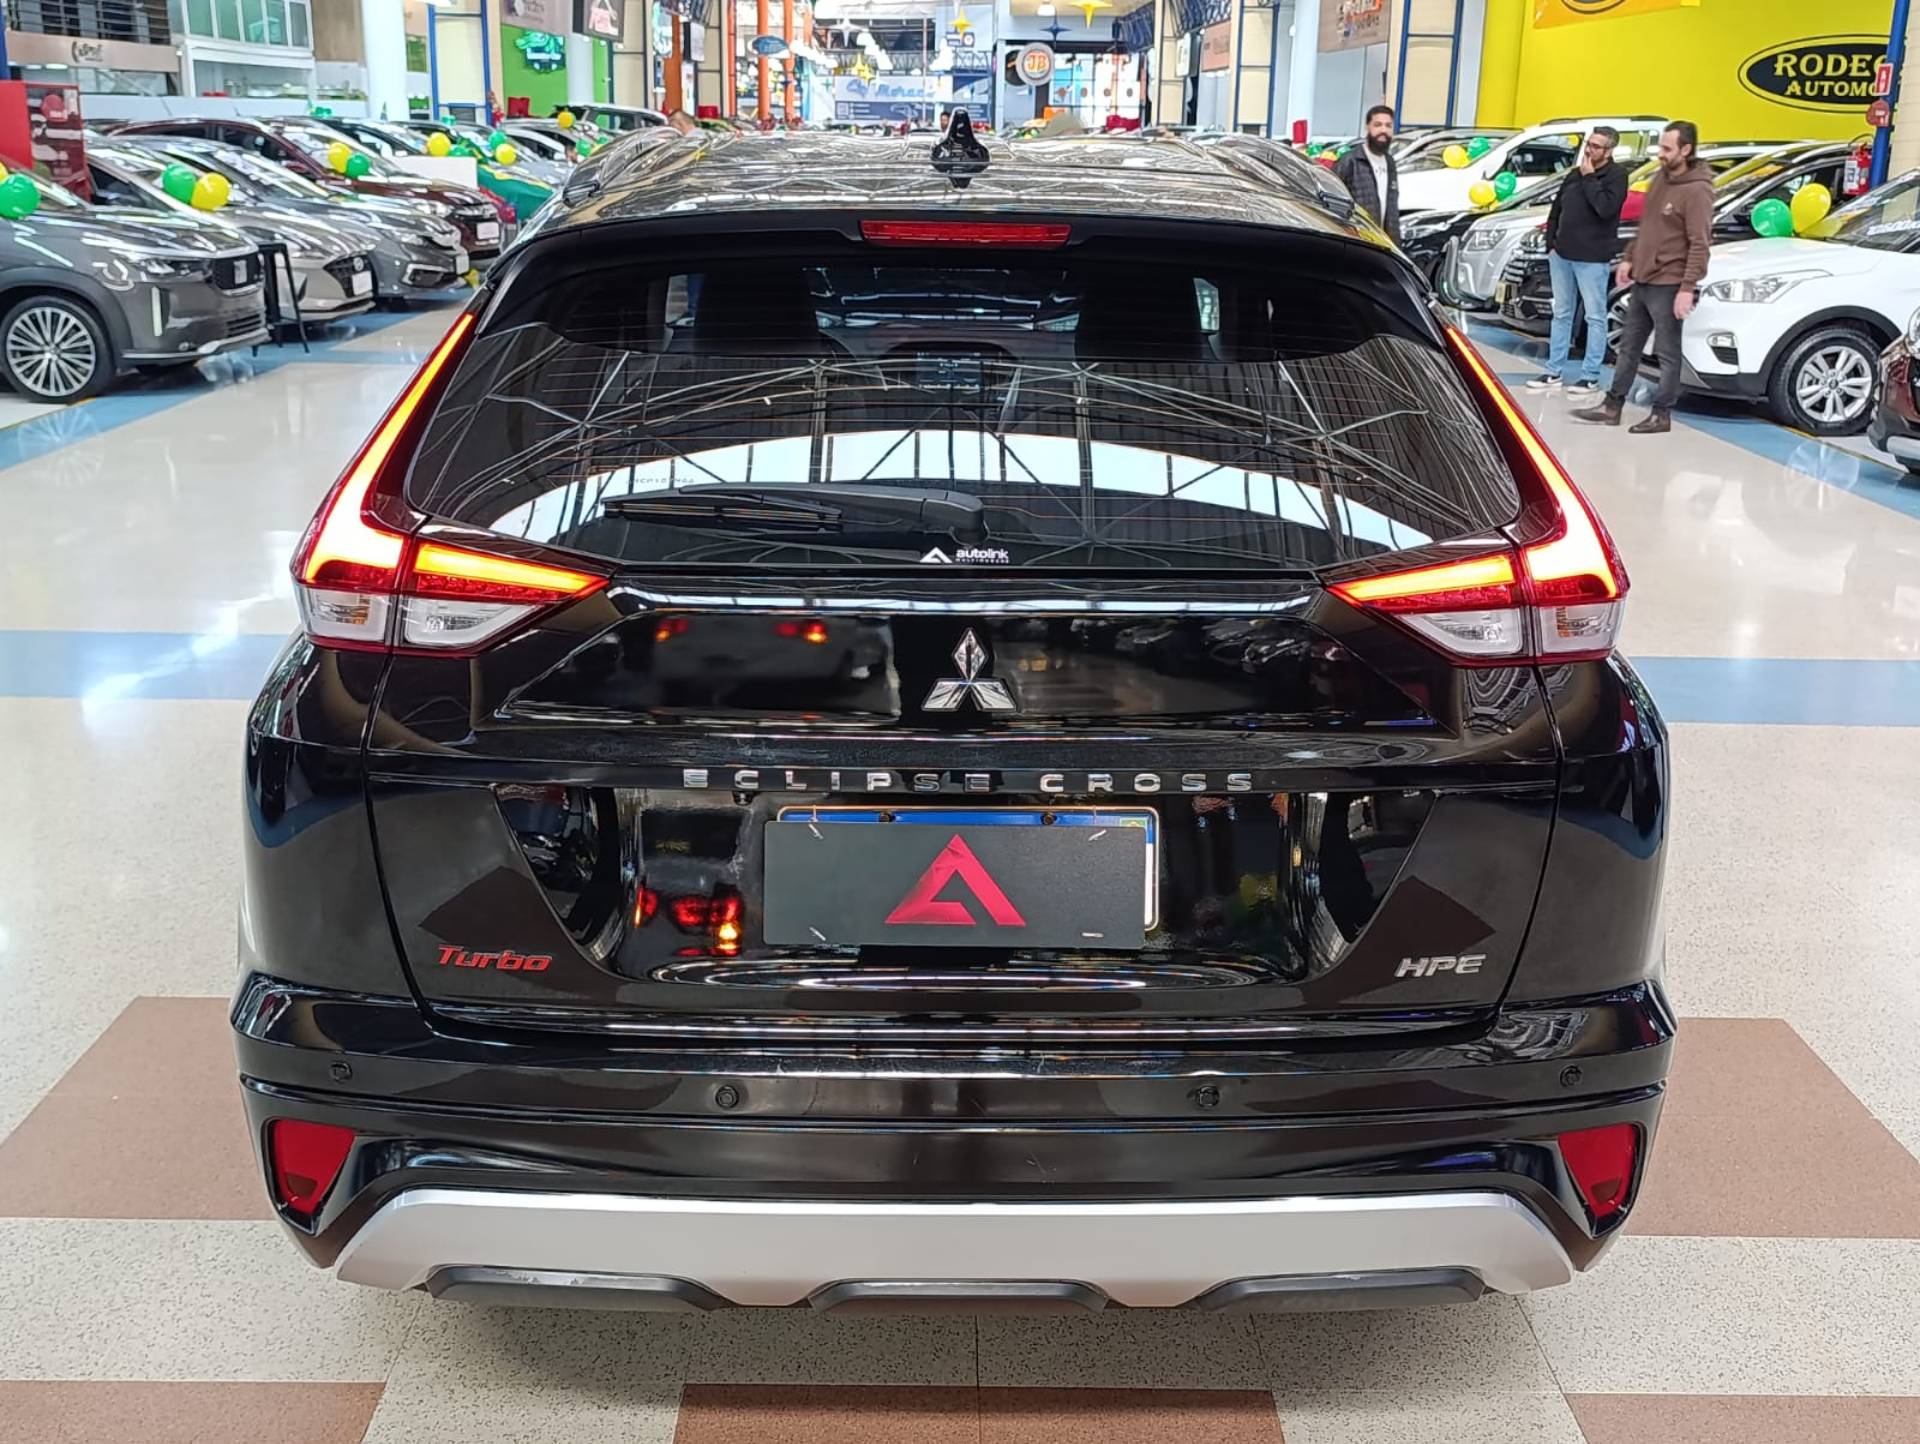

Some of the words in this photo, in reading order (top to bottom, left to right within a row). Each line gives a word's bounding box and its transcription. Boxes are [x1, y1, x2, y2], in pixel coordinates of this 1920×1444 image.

[956, 548, 1009, 559] autolink
[683, 768, 991, 792] ECLIPSE
[1039, 773, 1252, 793] CROSS
[438, 944, 553, 971] Turbo
[1394, 953, 1487, 978] HPE
